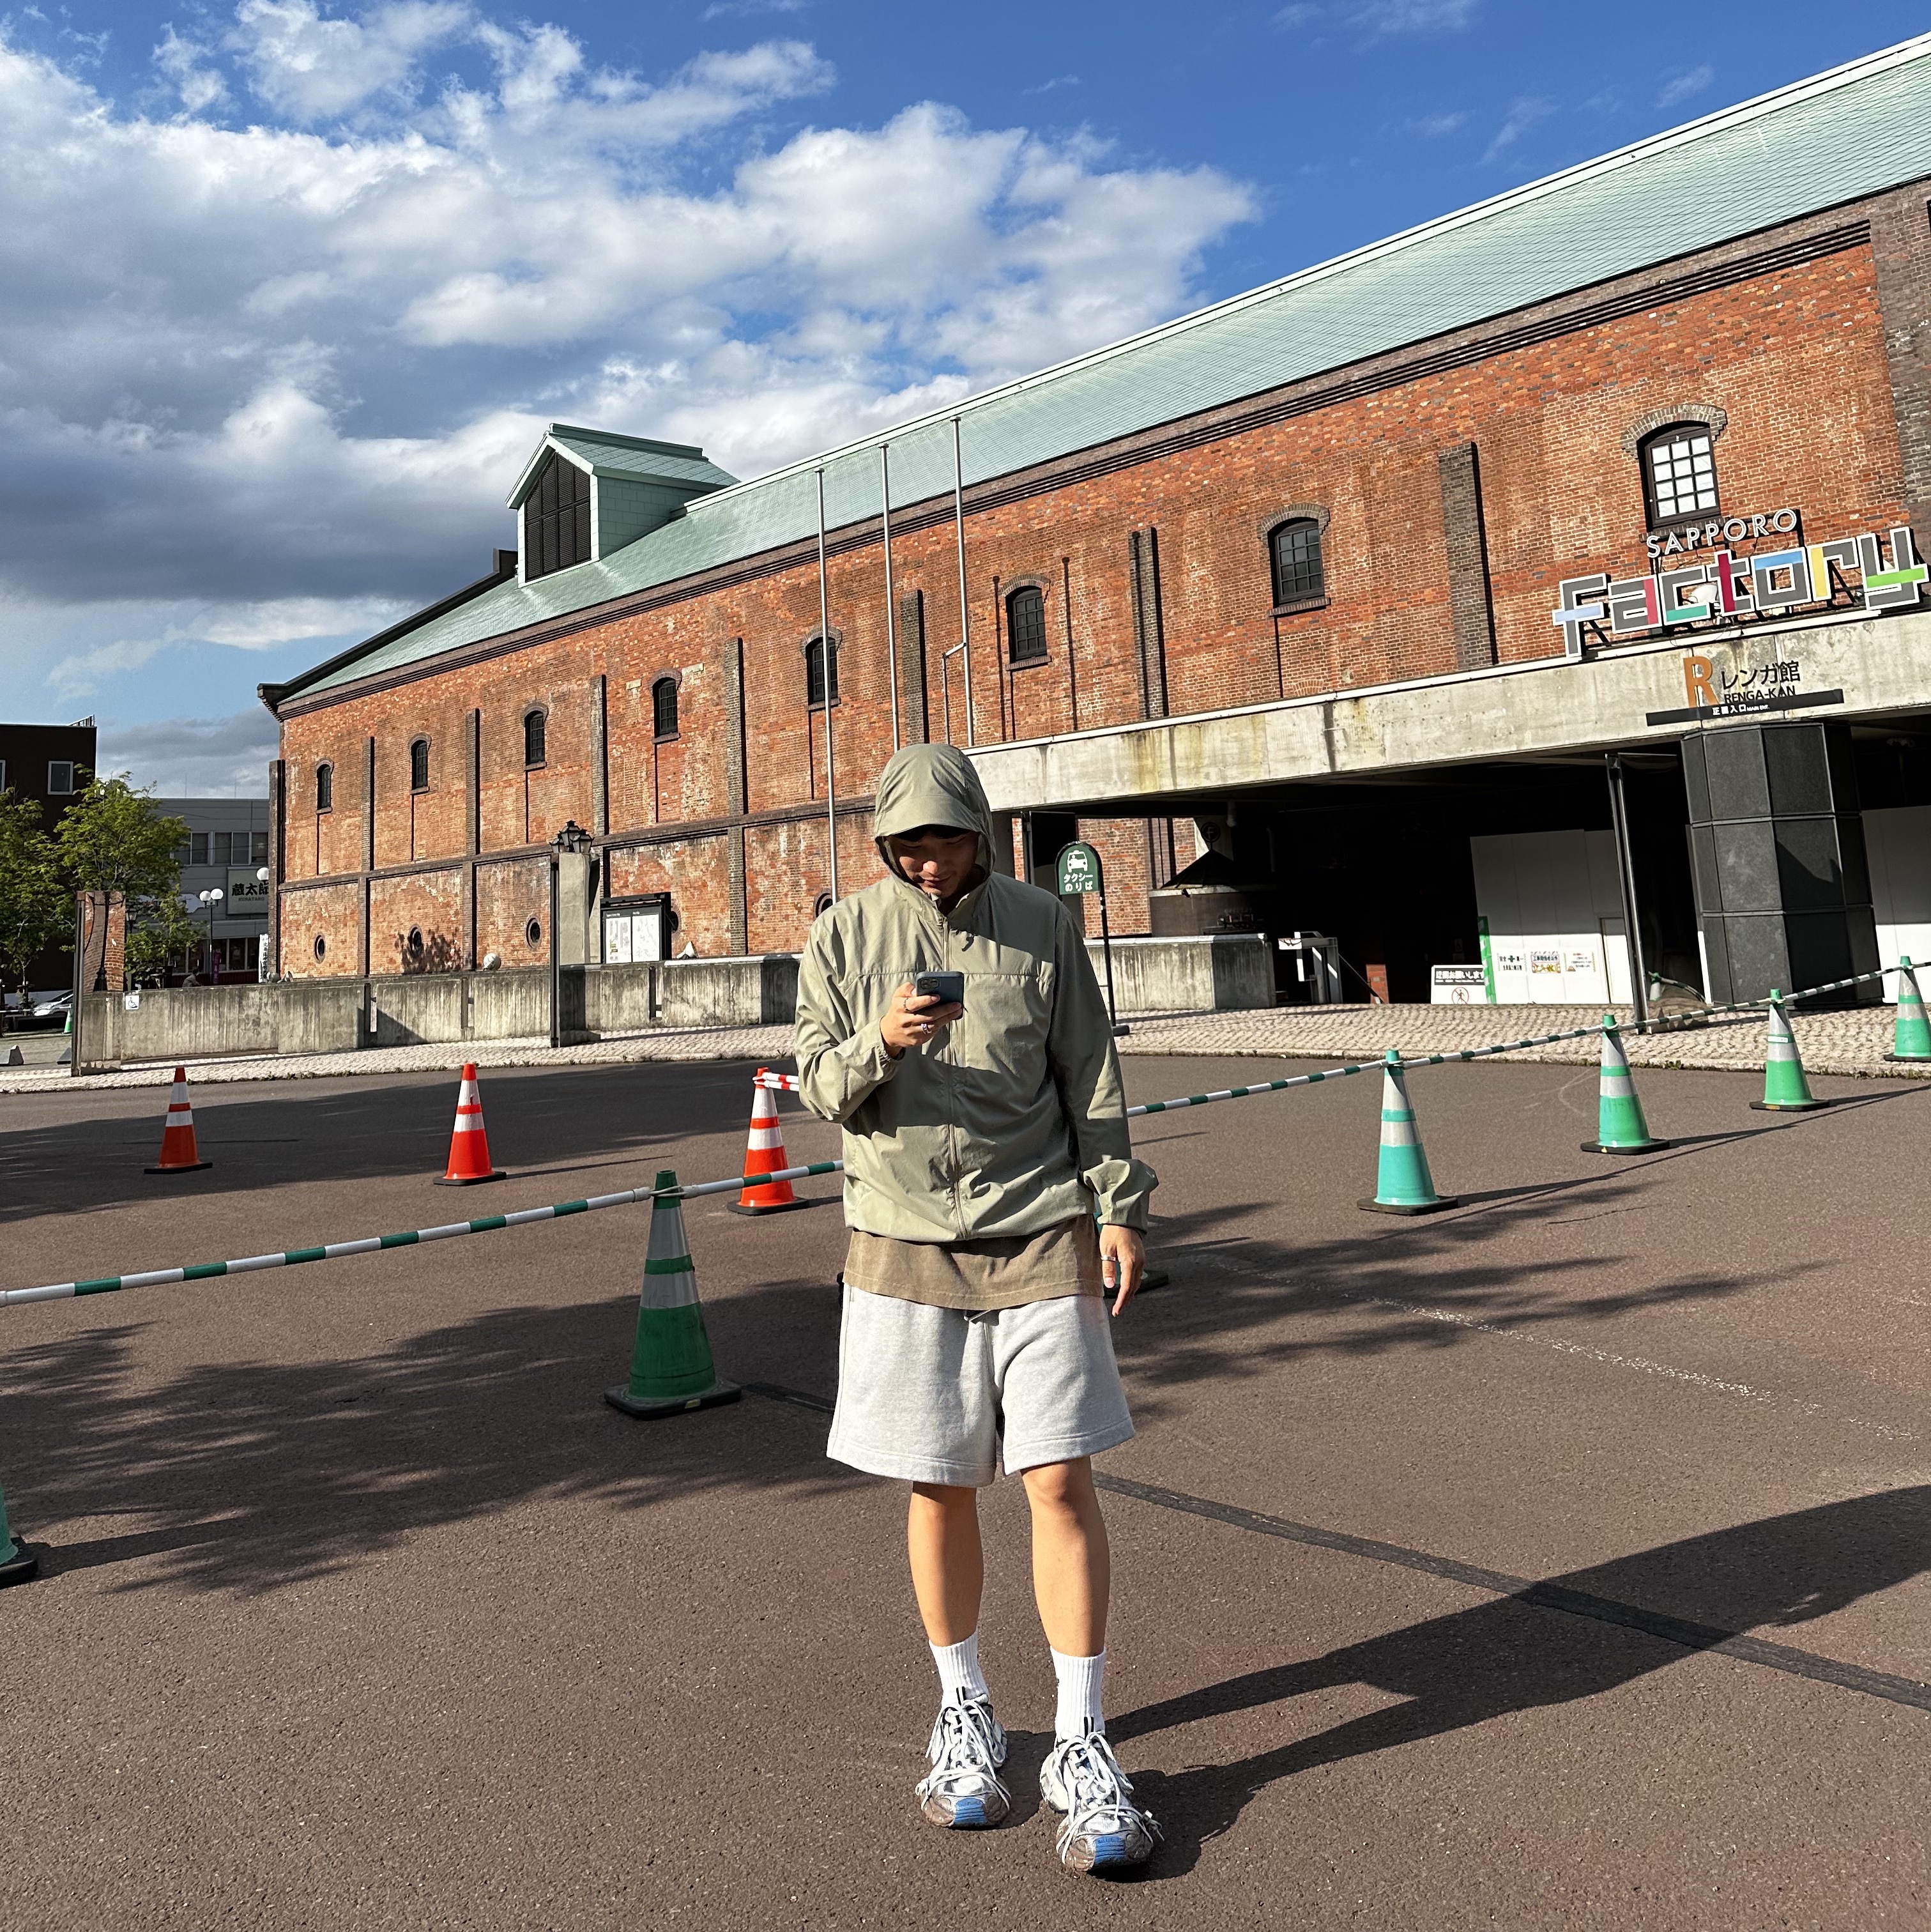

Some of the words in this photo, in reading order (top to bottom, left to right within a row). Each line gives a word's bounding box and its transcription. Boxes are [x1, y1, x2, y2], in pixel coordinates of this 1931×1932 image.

[1646, 508, 1797, 558] SAPPORO
[1683, 656, 1720, 709] R
[1721, 660, 1801, 690] レンガ館
[1724, 685, 1796, 704] RENGA-KAN
[1064, 873, 1094, 883] タクシー
[1065, 881, 1093, 892] のりば
